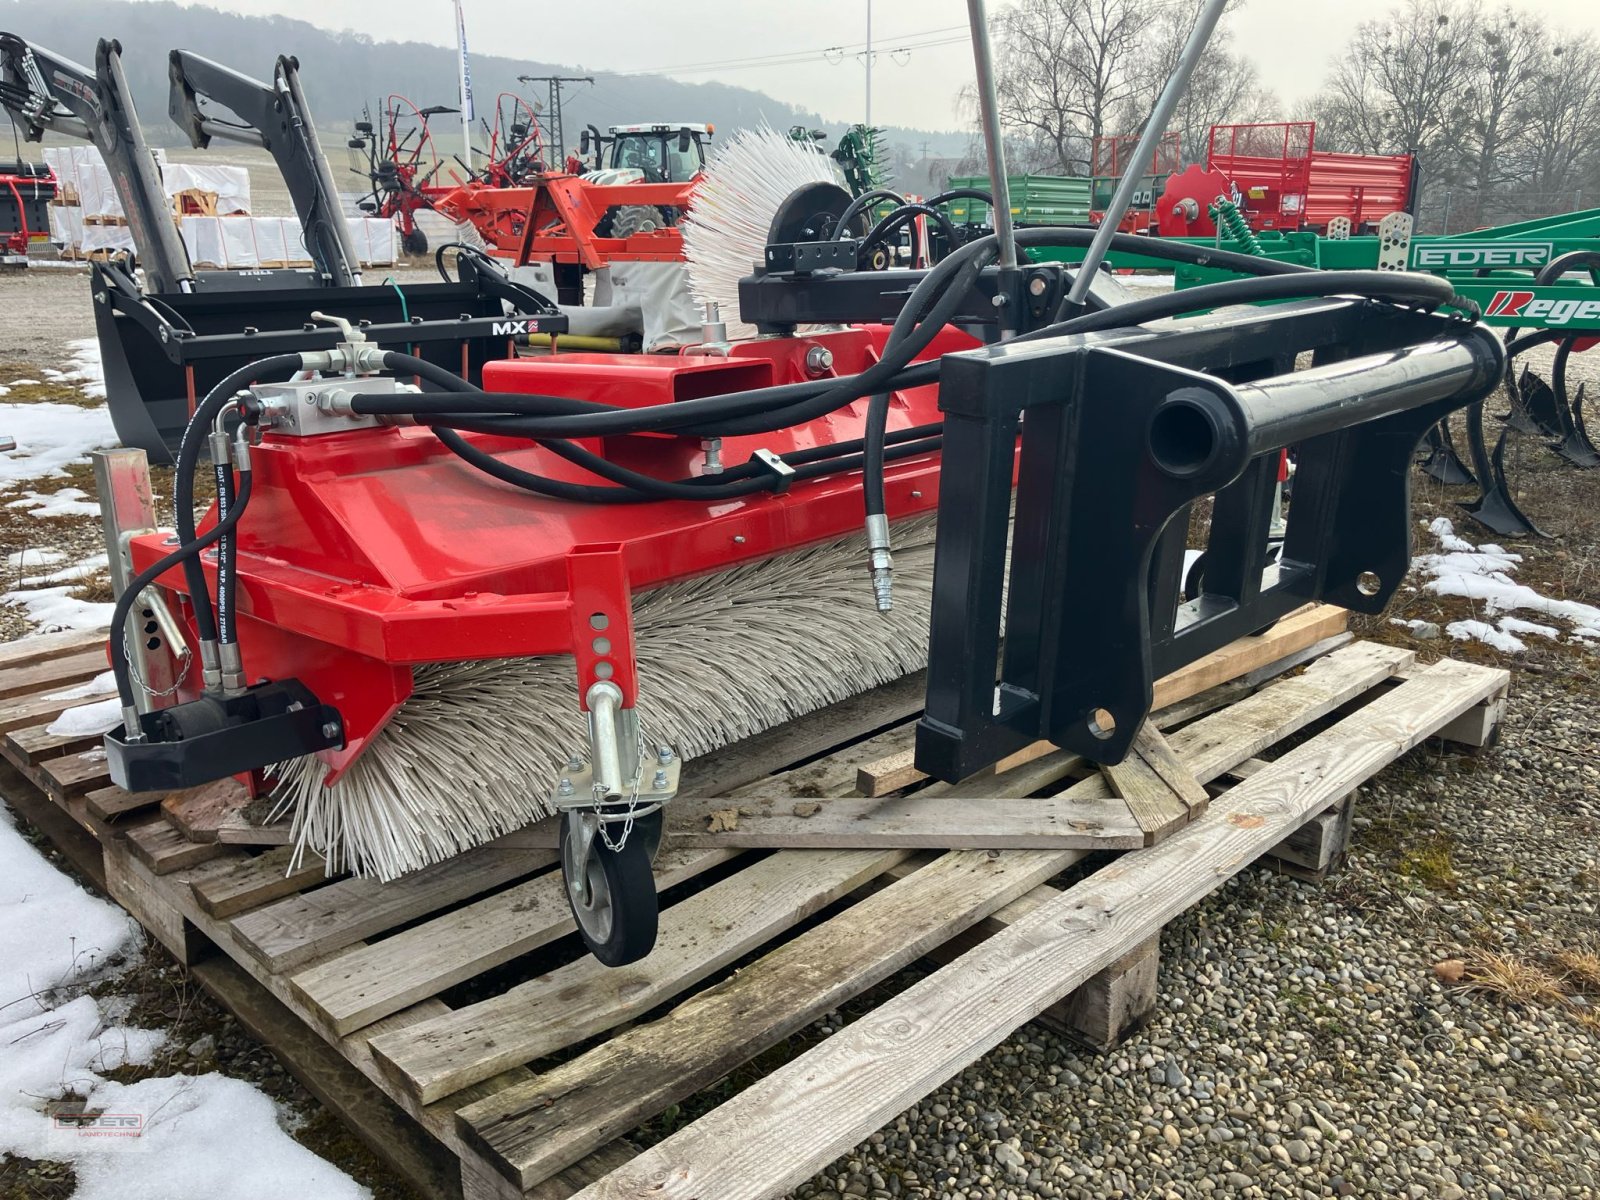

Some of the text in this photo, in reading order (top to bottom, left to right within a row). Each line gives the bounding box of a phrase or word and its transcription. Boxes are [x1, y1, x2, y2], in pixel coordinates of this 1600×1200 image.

[1418, 248, 1548, 265] EDER
[492, 320, 528, 336] MX
[216, 466, 224, 482] R2AT
[219, 487, 226, 496] EN
[219, 617, 227, 644] 275BAR
